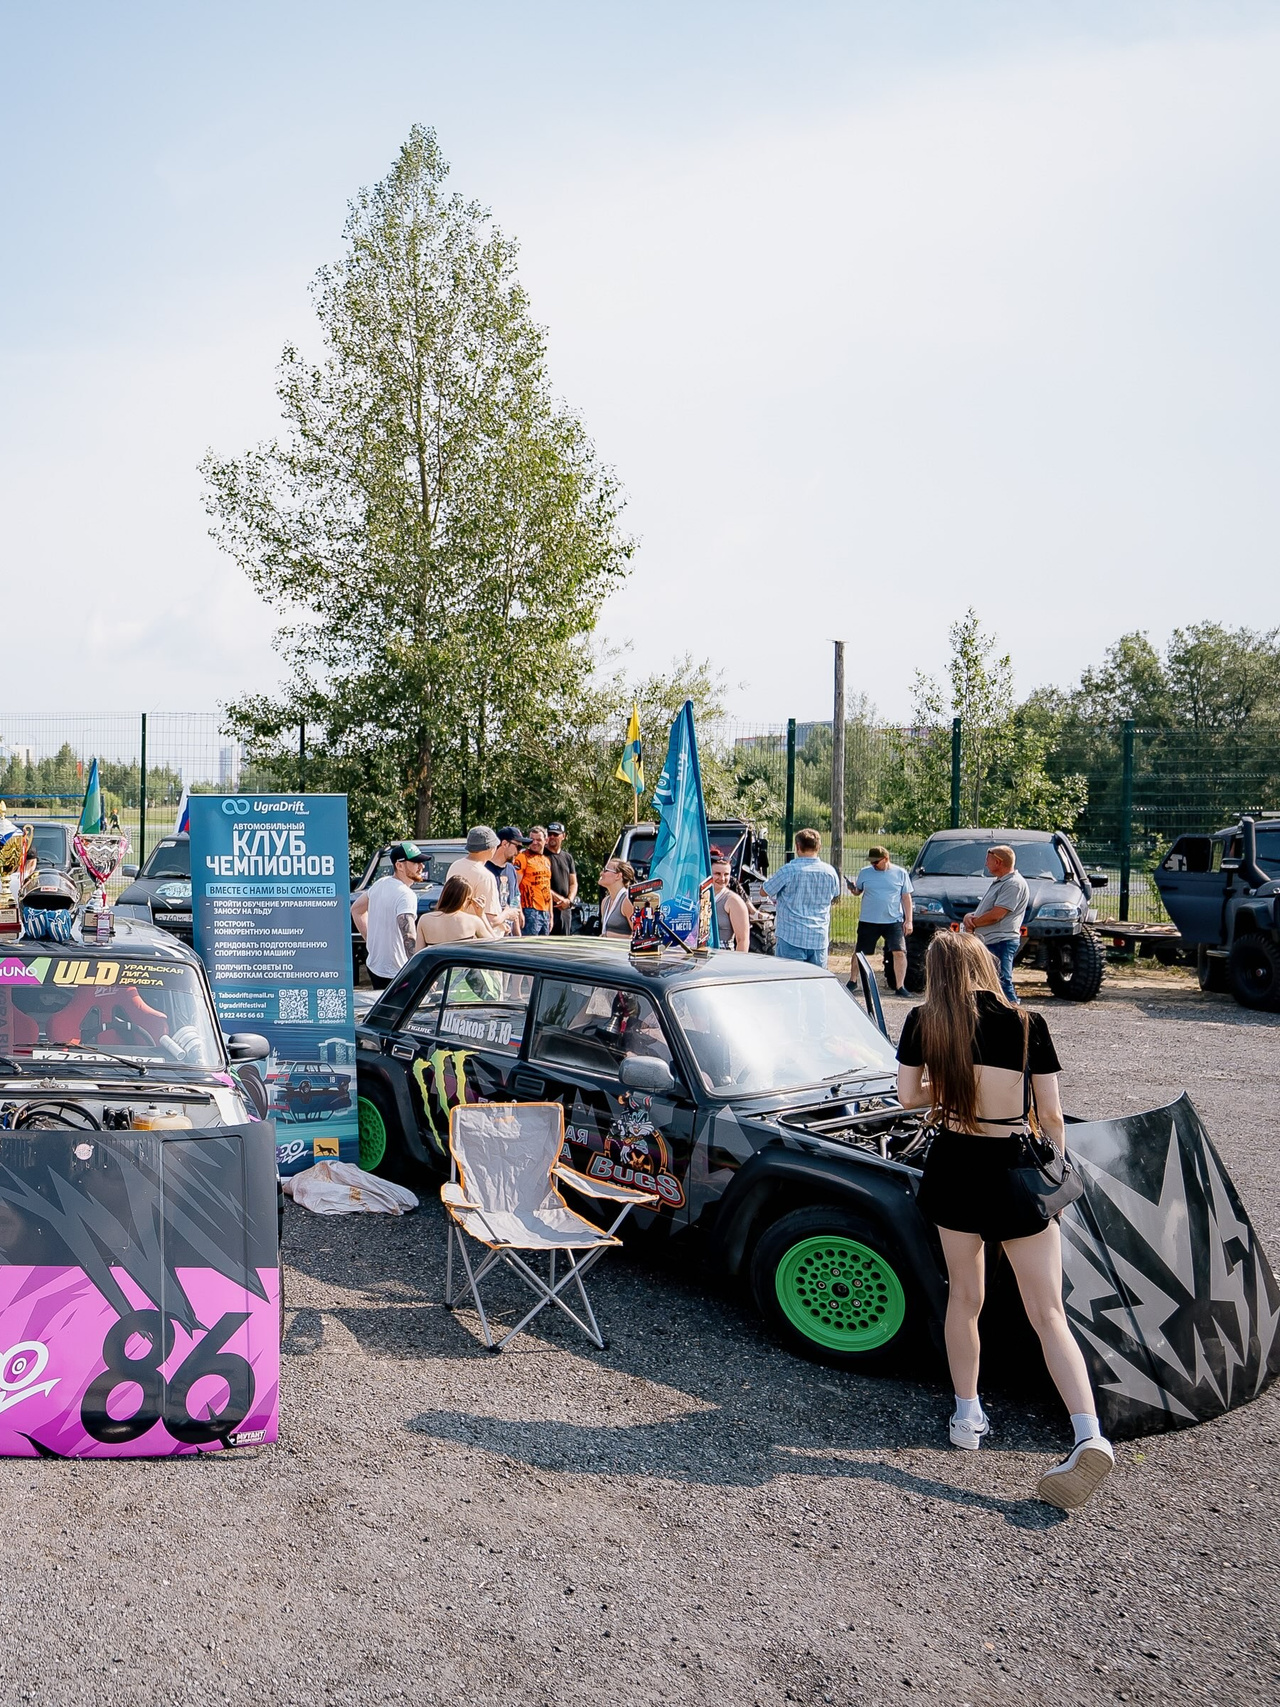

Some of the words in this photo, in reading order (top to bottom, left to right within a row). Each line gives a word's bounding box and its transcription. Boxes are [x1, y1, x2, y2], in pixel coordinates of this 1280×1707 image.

[253, 801, 304, 814] UgraDrift
[233, 822, 305, 830] АВТОМОБИЛЬНЫЙ
[232, 831, 307, 856] КЛУБ
[206, 856, 335, 876] ЧЕМПИОНОВ
[209, 886, 241, 895] ВМЕСТЕ
[242, 886, 248, 895] С
[249, 886, 275, 895] НАМИ
[276, 886, 289, 895] ВЫ
[290, 886, 334, 895] СМОЖЕТЕ:
[213, 899, 242, 907] ПРОЙТИ
[242, 900, 280, 908] ОБУЧЕНИЕ
[280, 900, 338, 908] УПРАВЛЯЕМОМУ
[253, 908, 273, 916] ЛЬДУ
[213, 920, 255, 928] ПОСТРОИТЬ
[271, 928, 305, 936] МАШИНУ
[214, 941, 259, 949] АРЕНДОВАТЬ
[260, 941, 328, 949] ПОДГОТОВЛЕННУЮ
[214, 949, 262, 957] СПОРТИВНУЮ
[263, 949, 297, 957] МАШИНУ
[123, 964, 184, 975] УРАЛЬСКАЯ
[215, 963, 252, 971] ПОЛУЧИТЬ
[252, 963, 282, 971] СОВЕТЫ
[282, 963, 294, 971] ПО
[53, 960, 120, 986] ULD
[121, 970, 150, 978] ЛИГА
[215, 971, 263, 980] ДОРАБОТКАМ
[263, 971, 319, 979] СОБСТВЕННОГО
[320, 971, 339, 979] АВТО
[118, 977, 164, 986] ДРИФТА
[407, 1025, 432, 1034] FIGURE
[440, 1011, 485, 1039] Шмаков
[487, 1020, 512, 1045] В.Ю
[590, 1155, 681, 1202] BUGS
[80, 1308, 256, 1444] 86
